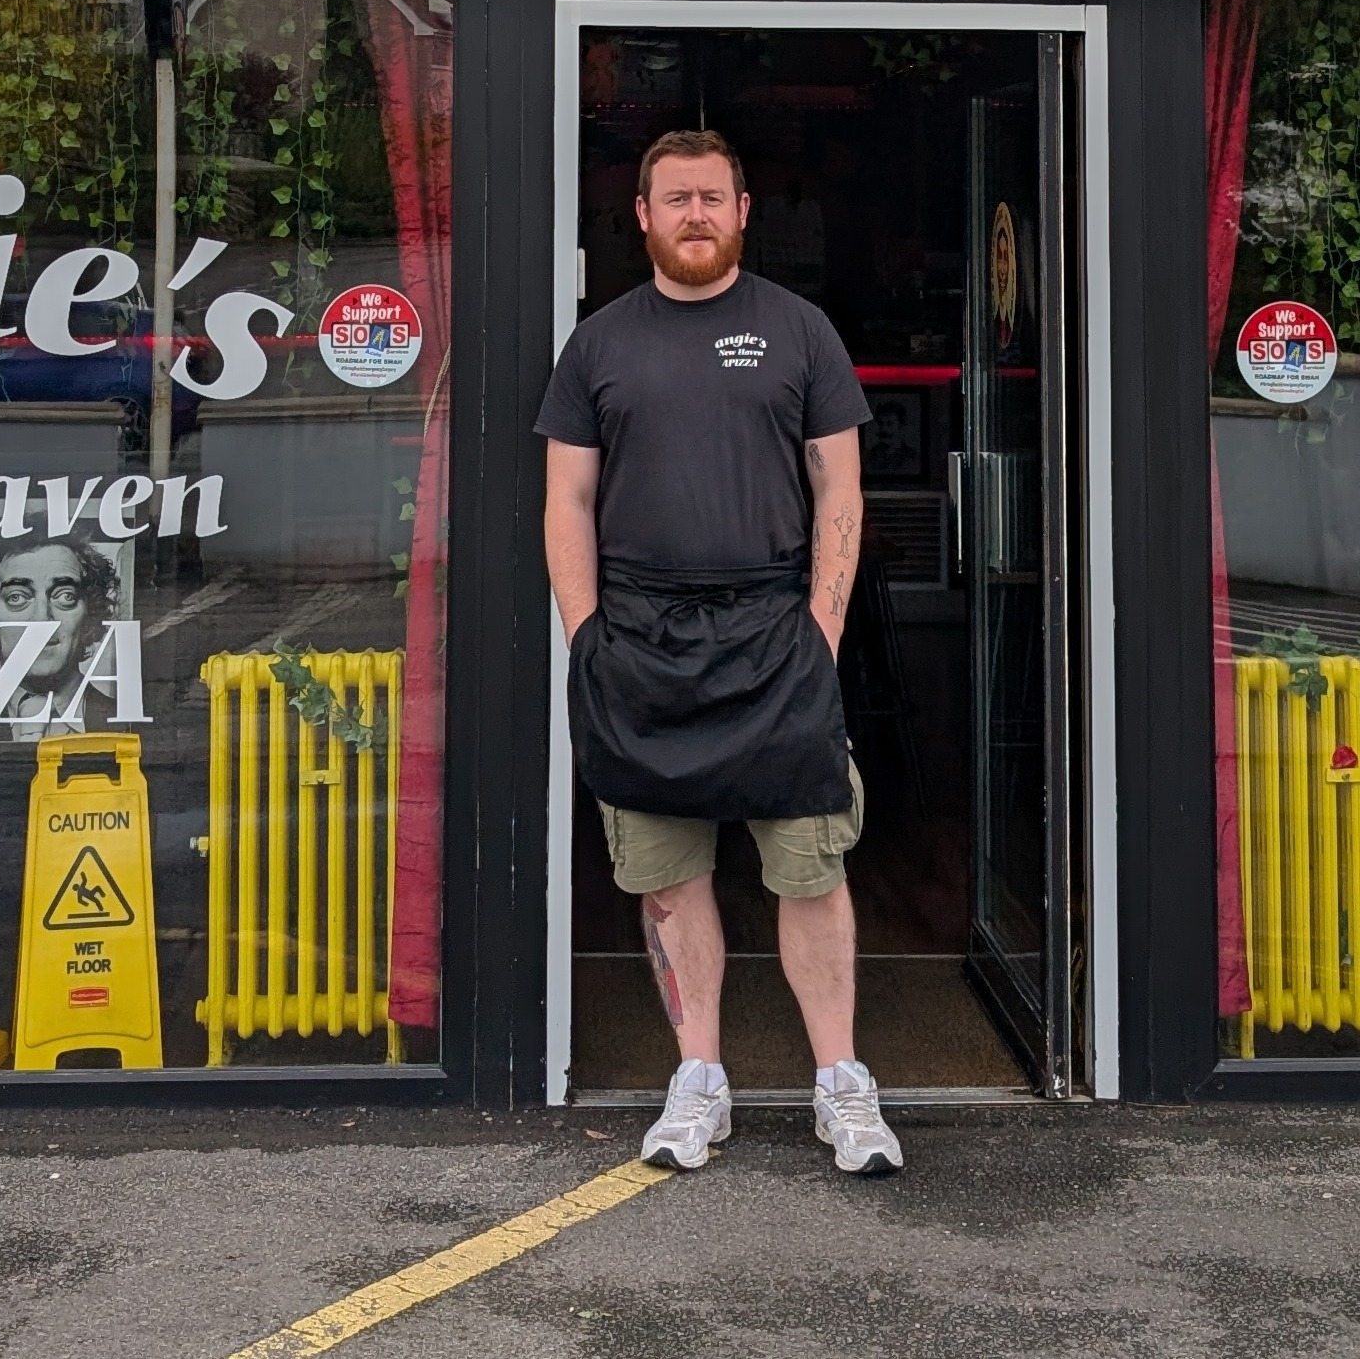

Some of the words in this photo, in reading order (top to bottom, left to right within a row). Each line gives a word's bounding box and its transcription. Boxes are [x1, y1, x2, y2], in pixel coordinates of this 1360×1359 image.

[360, 292, 382, 307] We
[342, 304, 401, 324] Support
[1275, 309, 1296, 323] We
[1258, 321, 1316, 340] Support
[714, 332, 767, 349] angie's
[718, 349, 736, 357] New
[737, 348, 764, 357] Haven
[721, 358, 758, 368] APIZZA
[48, 811, 131, 833] CAUTION
[74, 941, 105, 957] WET
[66, 959, 112, 975] FLOOR
